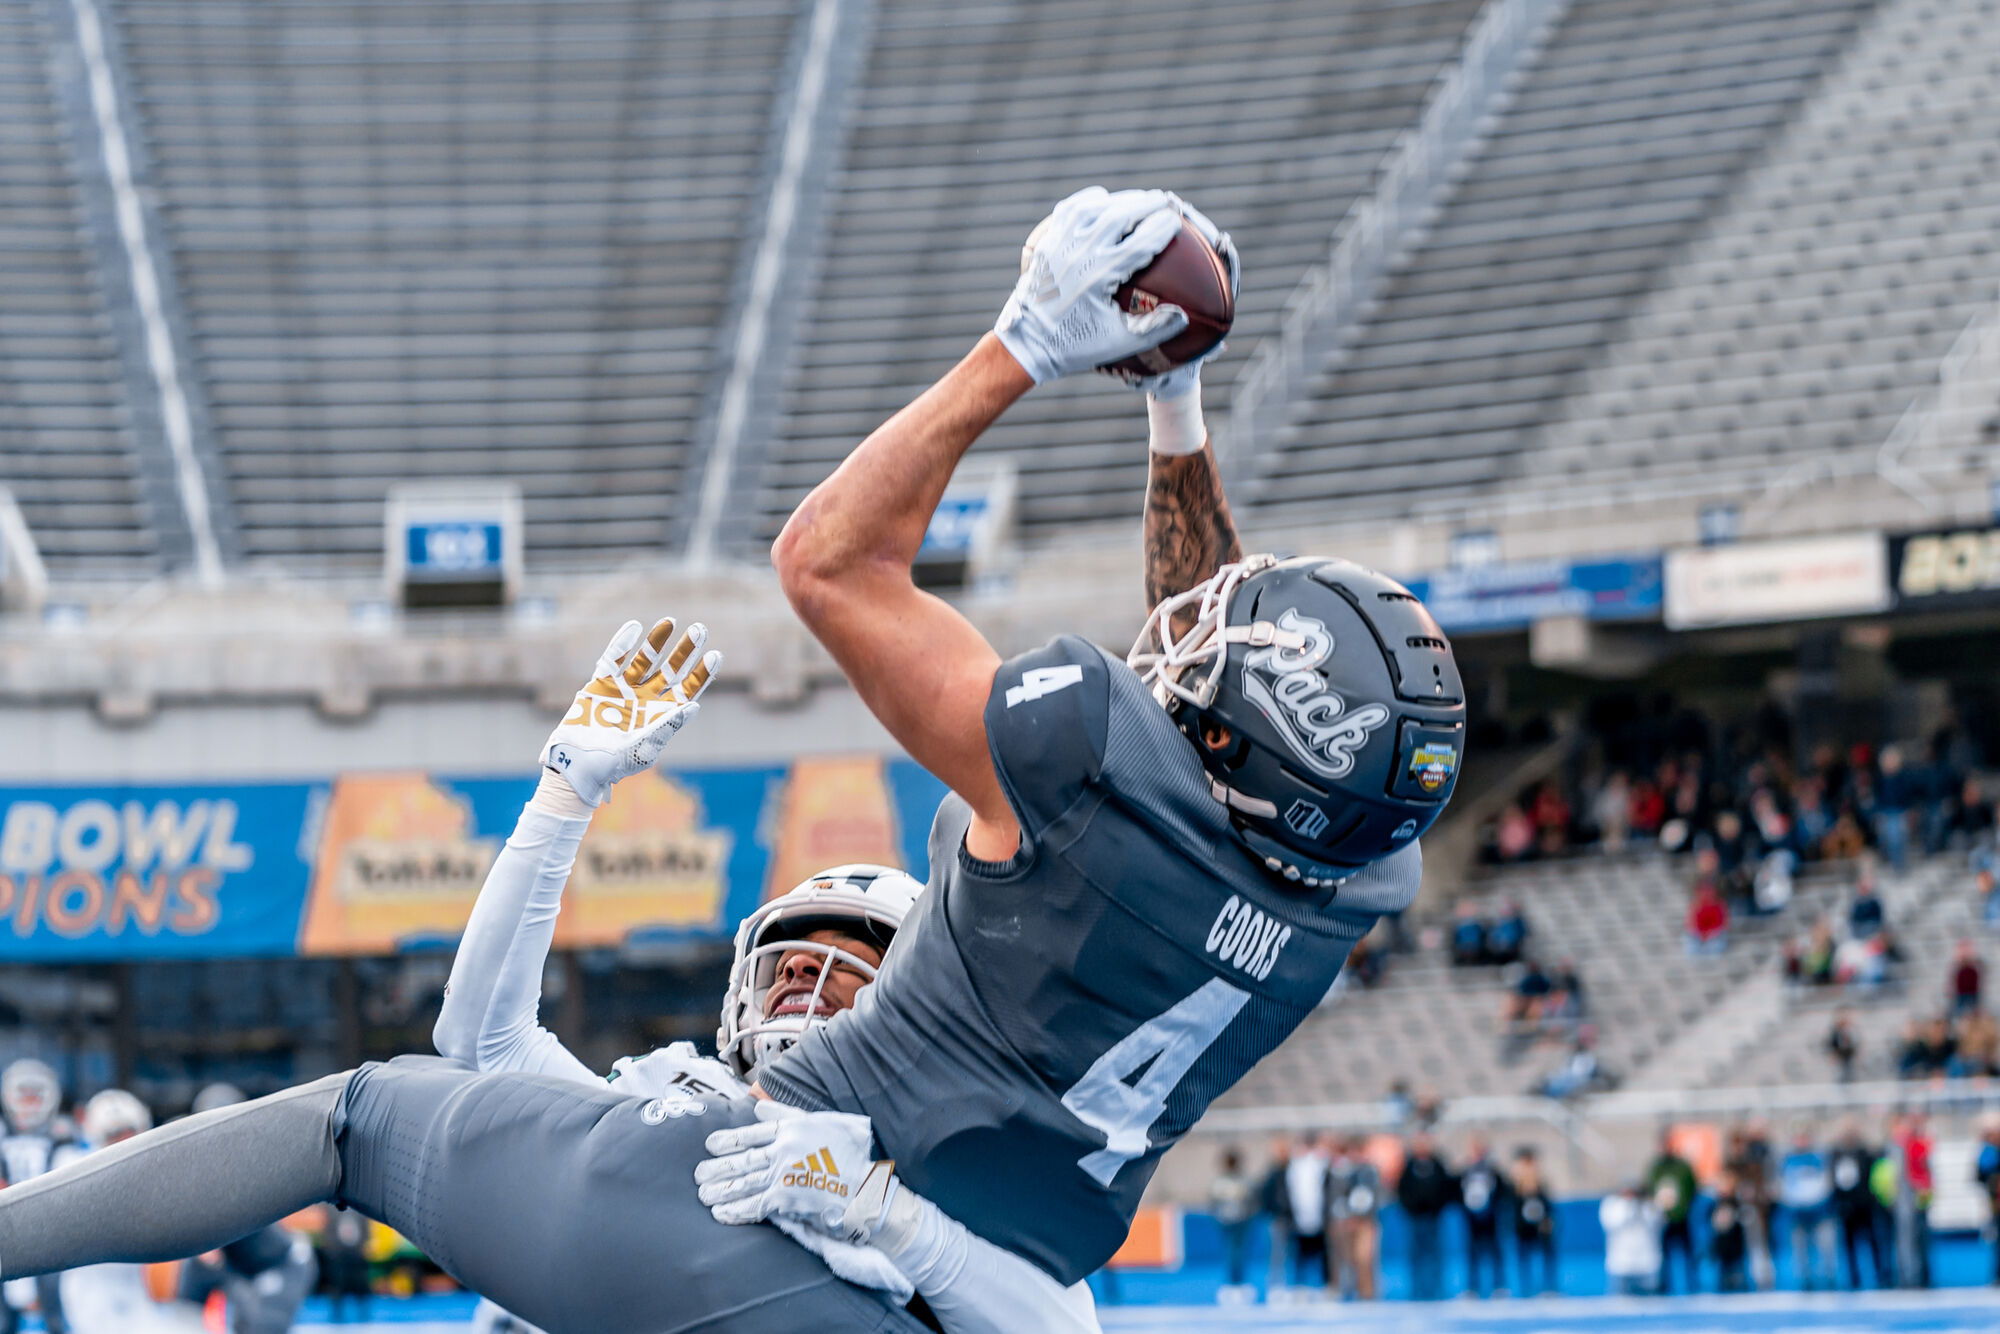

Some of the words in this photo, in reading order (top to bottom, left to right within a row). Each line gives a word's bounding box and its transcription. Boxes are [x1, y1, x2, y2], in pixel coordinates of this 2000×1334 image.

[1005, 664, 1083, 709] 4
[1241, 606, 1390, 780] Pack
[2, 799, 254, 872] BOWL
[1205, 894, 1292, 982] COOKS
[1060, 975, 1252, 1188] 4
[783, 1169, 849, 1197] adidas
